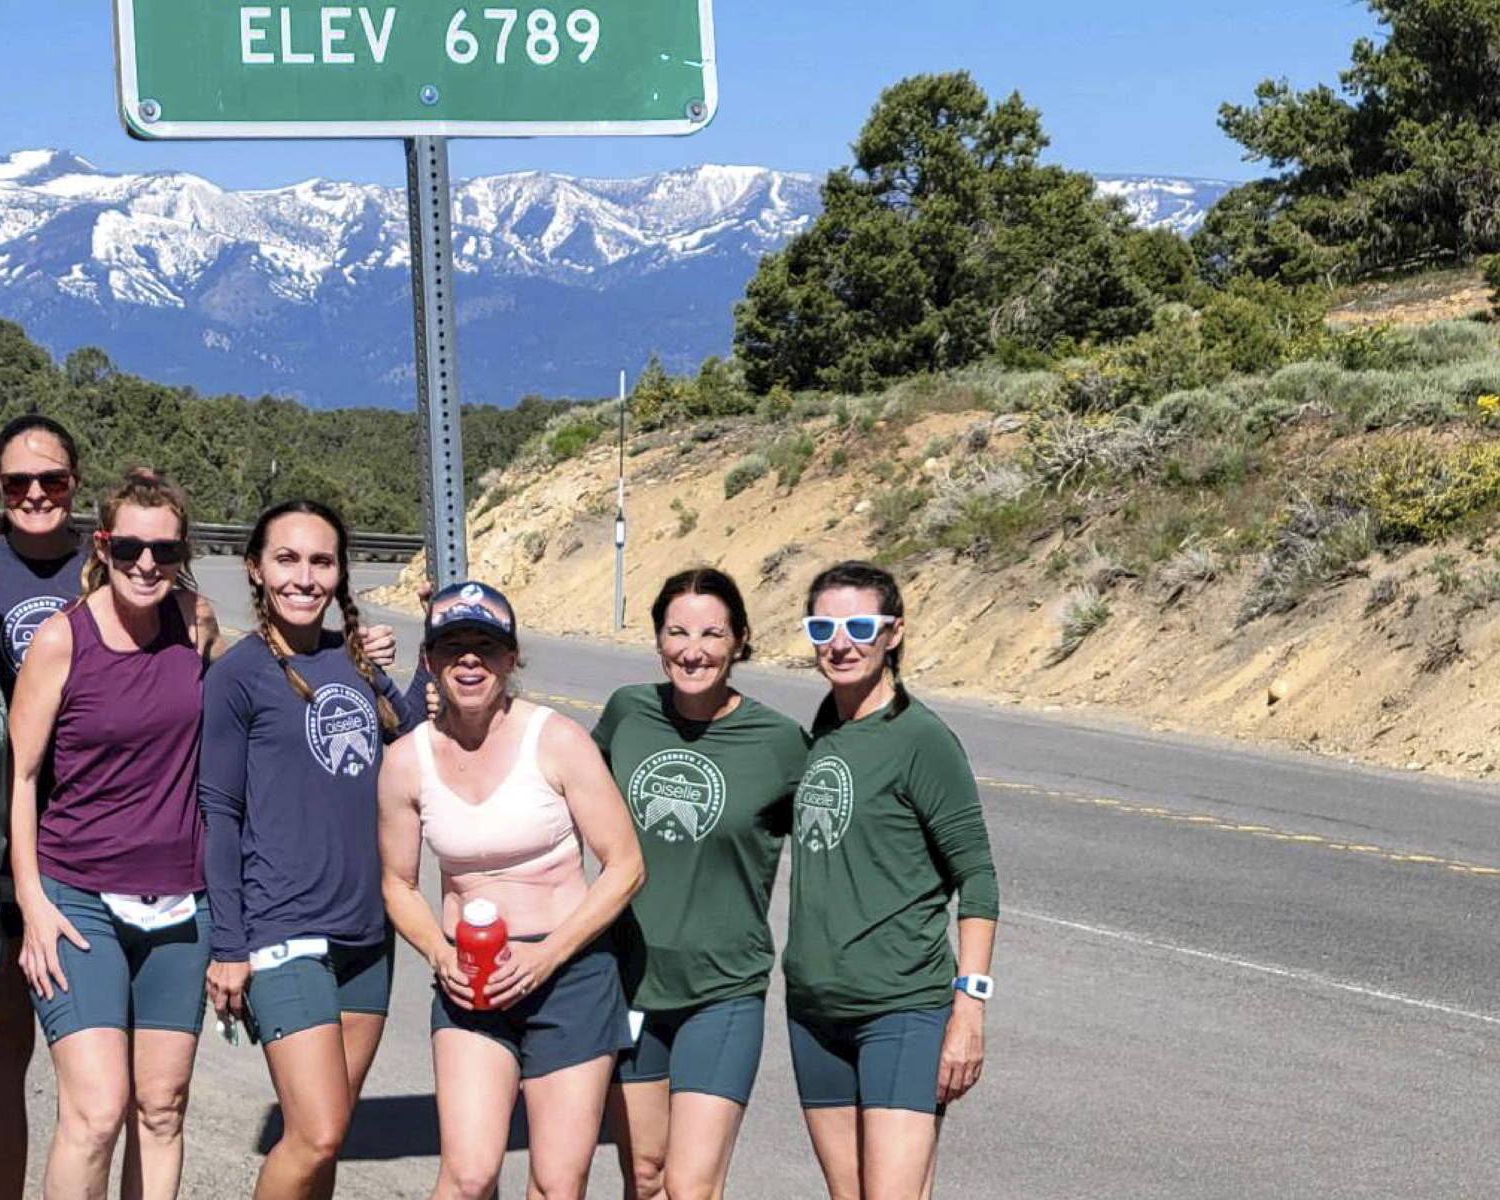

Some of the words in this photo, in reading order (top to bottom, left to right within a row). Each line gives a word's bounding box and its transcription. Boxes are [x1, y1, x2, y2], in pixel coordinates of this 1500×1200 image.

[241, 7, 396, 64] ELEV
[445, 9, 600, 65] 6789
[325, 716, 362, 734] oiselle
[651, 781, 702, 801] oiselle
